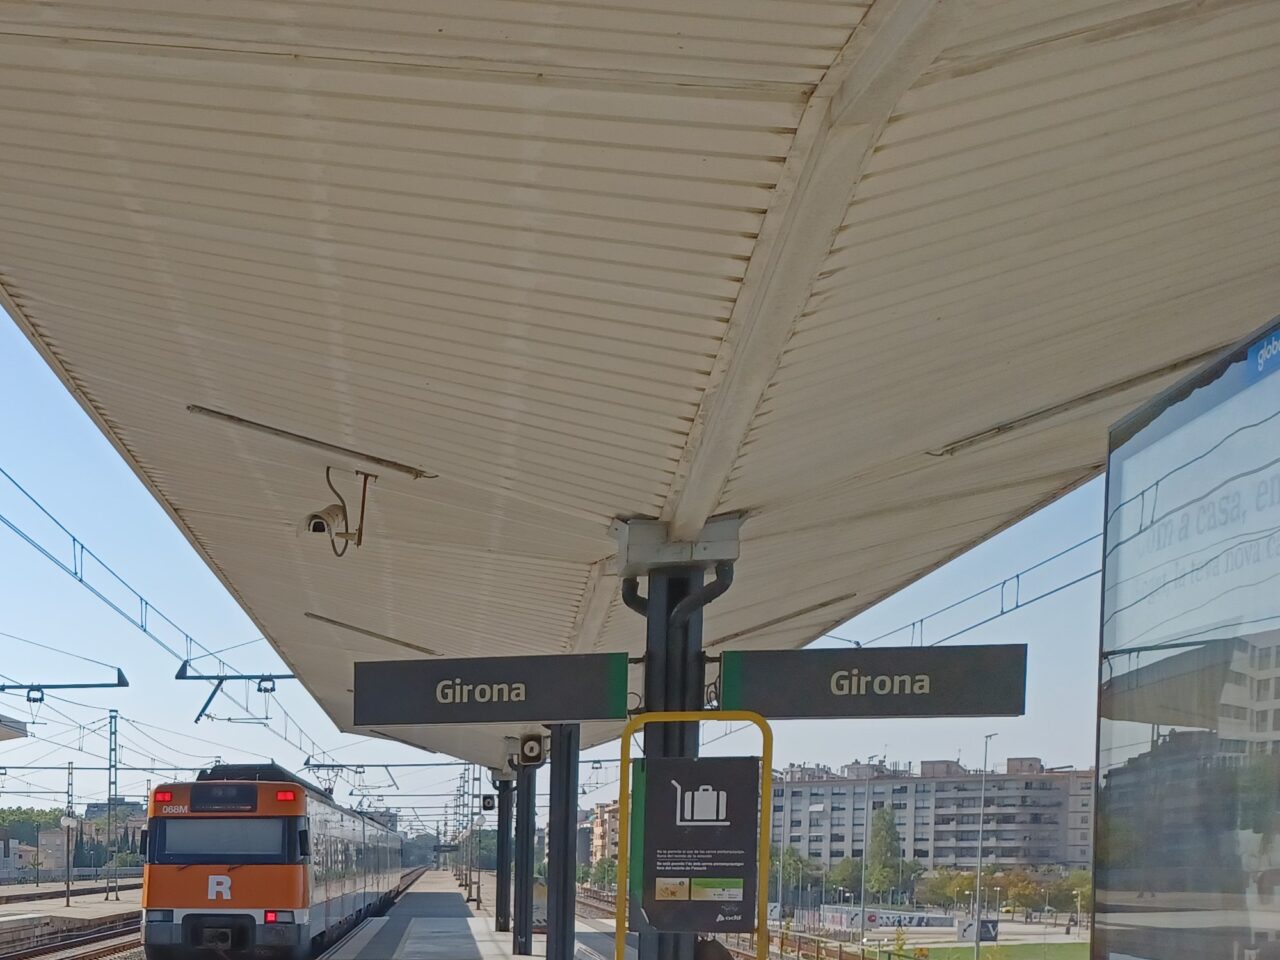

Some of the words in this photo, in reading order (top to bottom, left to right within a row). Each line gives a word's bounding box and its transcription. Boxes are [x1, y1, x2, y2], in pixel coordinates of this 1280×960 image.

[436, 677, 526, 704] Girona
[830, 668, 931, 696] Girona
[207, 875, 232, 900] R
